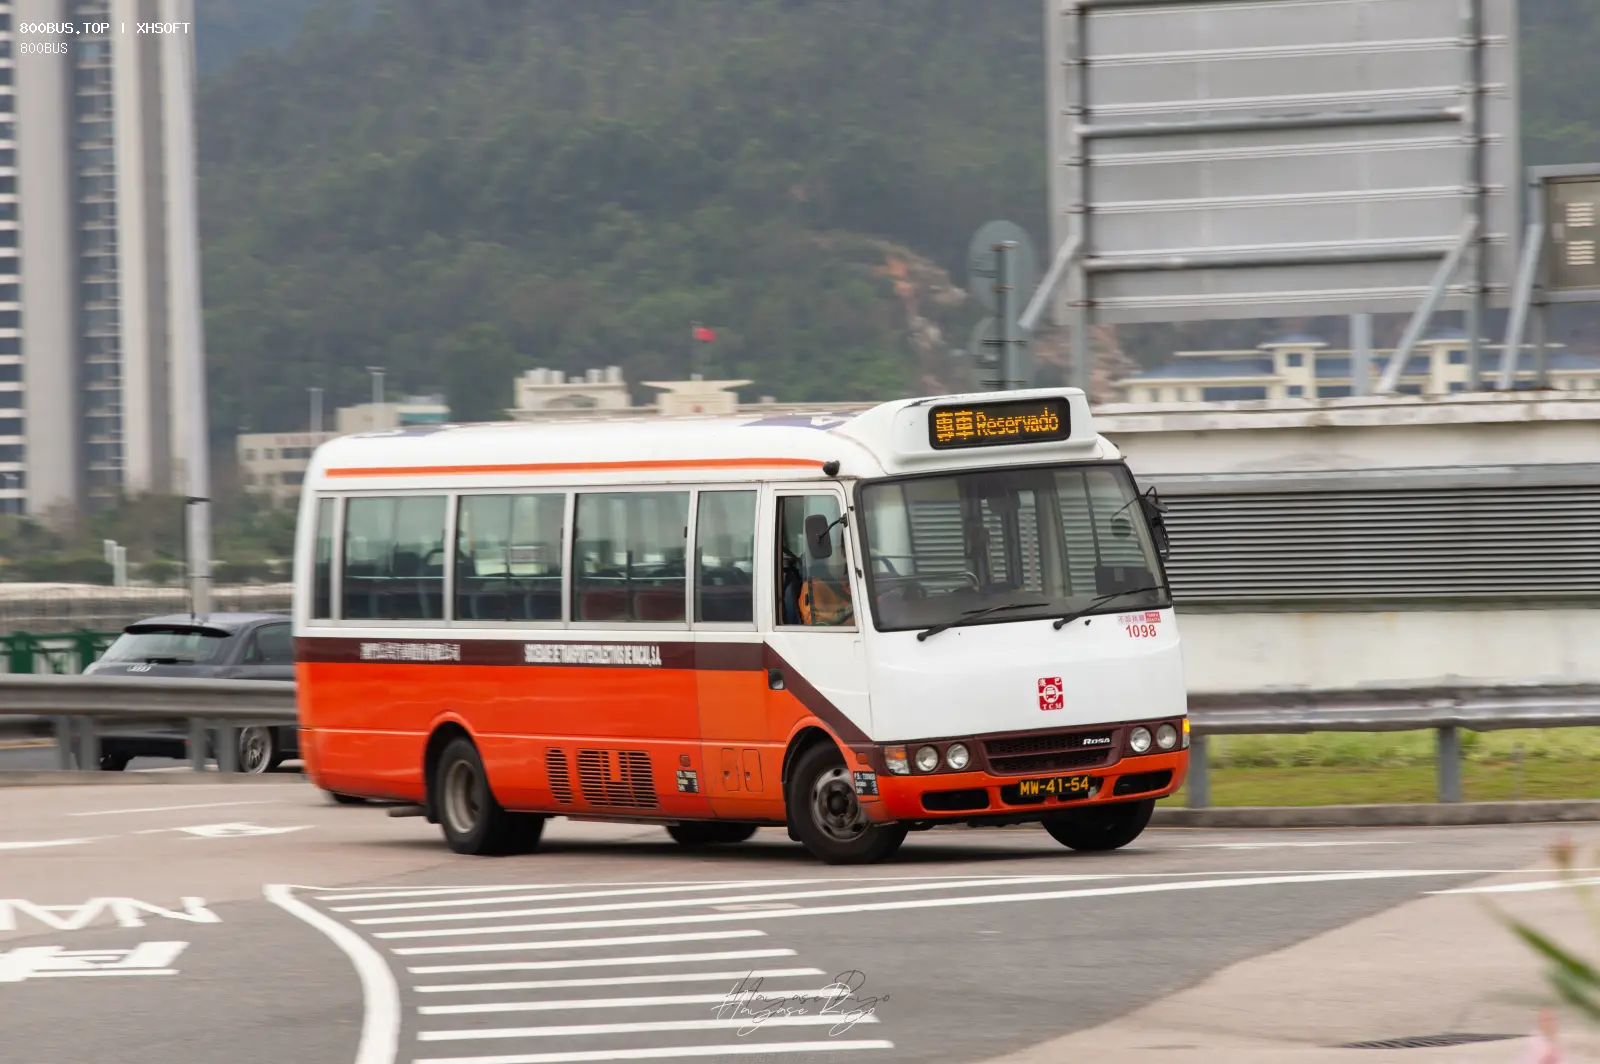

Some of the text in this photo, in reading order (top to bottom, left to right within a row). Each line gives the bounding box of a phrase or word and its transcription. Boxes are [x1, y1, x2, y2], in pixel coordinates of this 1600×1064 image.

[976, 407, 1059, 437] Reservado
[1125, 624, 1157, 638] 1098
[1019, 776, 1089, 796] MW-41-54
